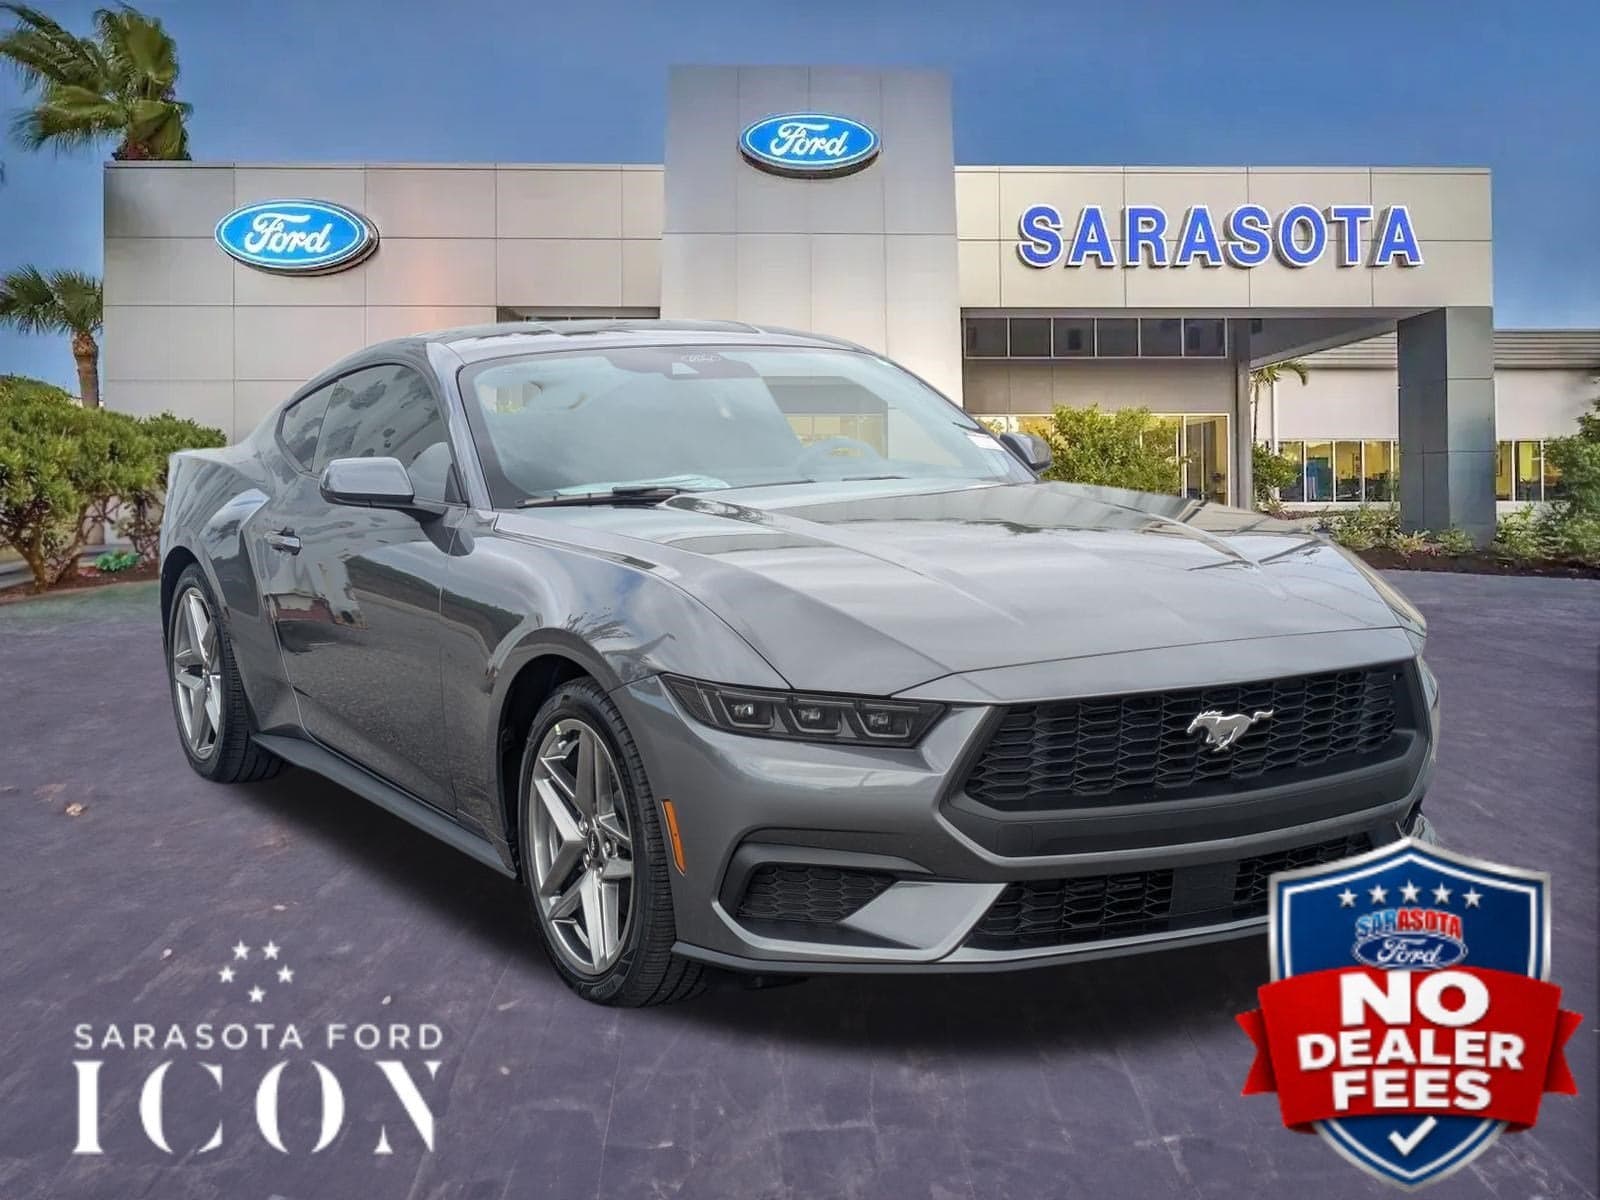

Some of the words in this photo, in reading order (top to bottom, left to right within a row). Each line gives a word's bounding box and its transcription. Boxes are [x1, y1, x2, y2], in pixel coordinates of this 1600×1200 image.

[770, 122, 849, 156] Ford
[244, 212, 333, 253] Ford
[1018, 203, 1425, 268] SARASOTA
